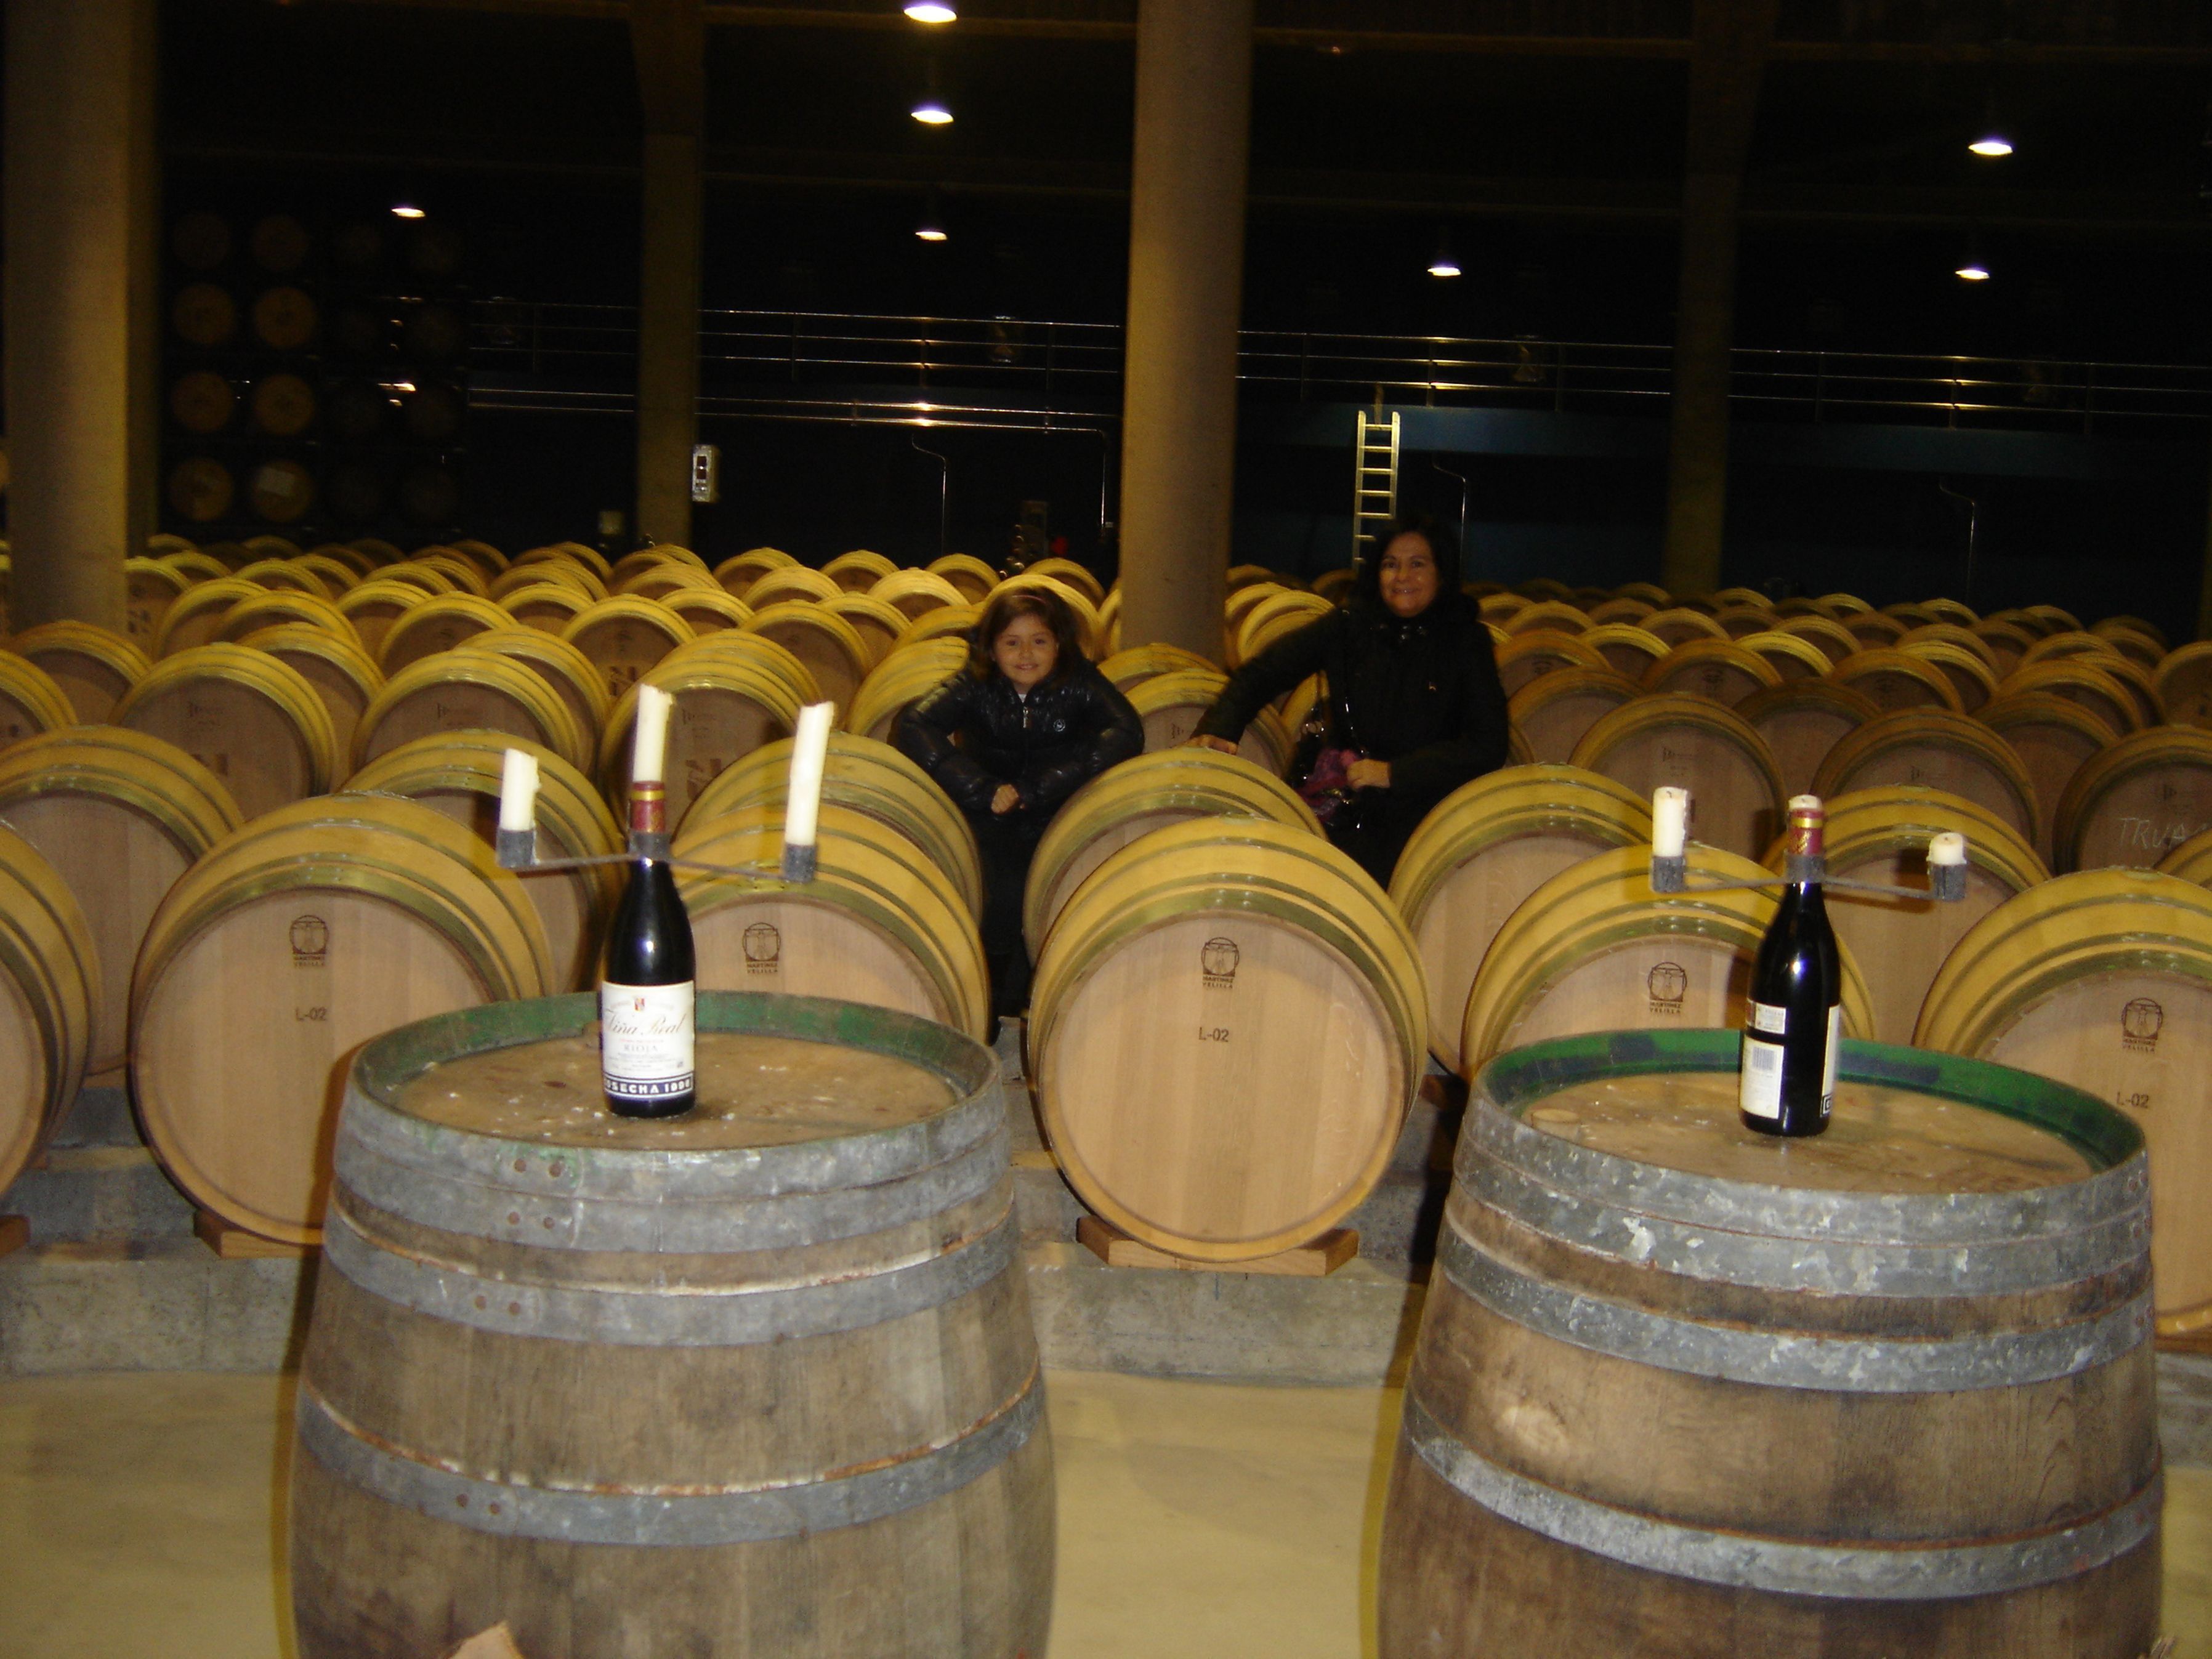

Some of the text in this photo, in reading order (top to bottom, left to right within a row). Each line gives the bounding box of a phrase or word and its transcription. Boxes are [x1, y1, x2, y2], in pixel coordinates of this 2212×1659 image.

[295, 1007, 327, 1022] L-02
[1198, 1027, 1230, 1043] L-02
[624, 1044, 658, 1052] RIOJA
[2116, 1092, 2150, 1108] L-02
